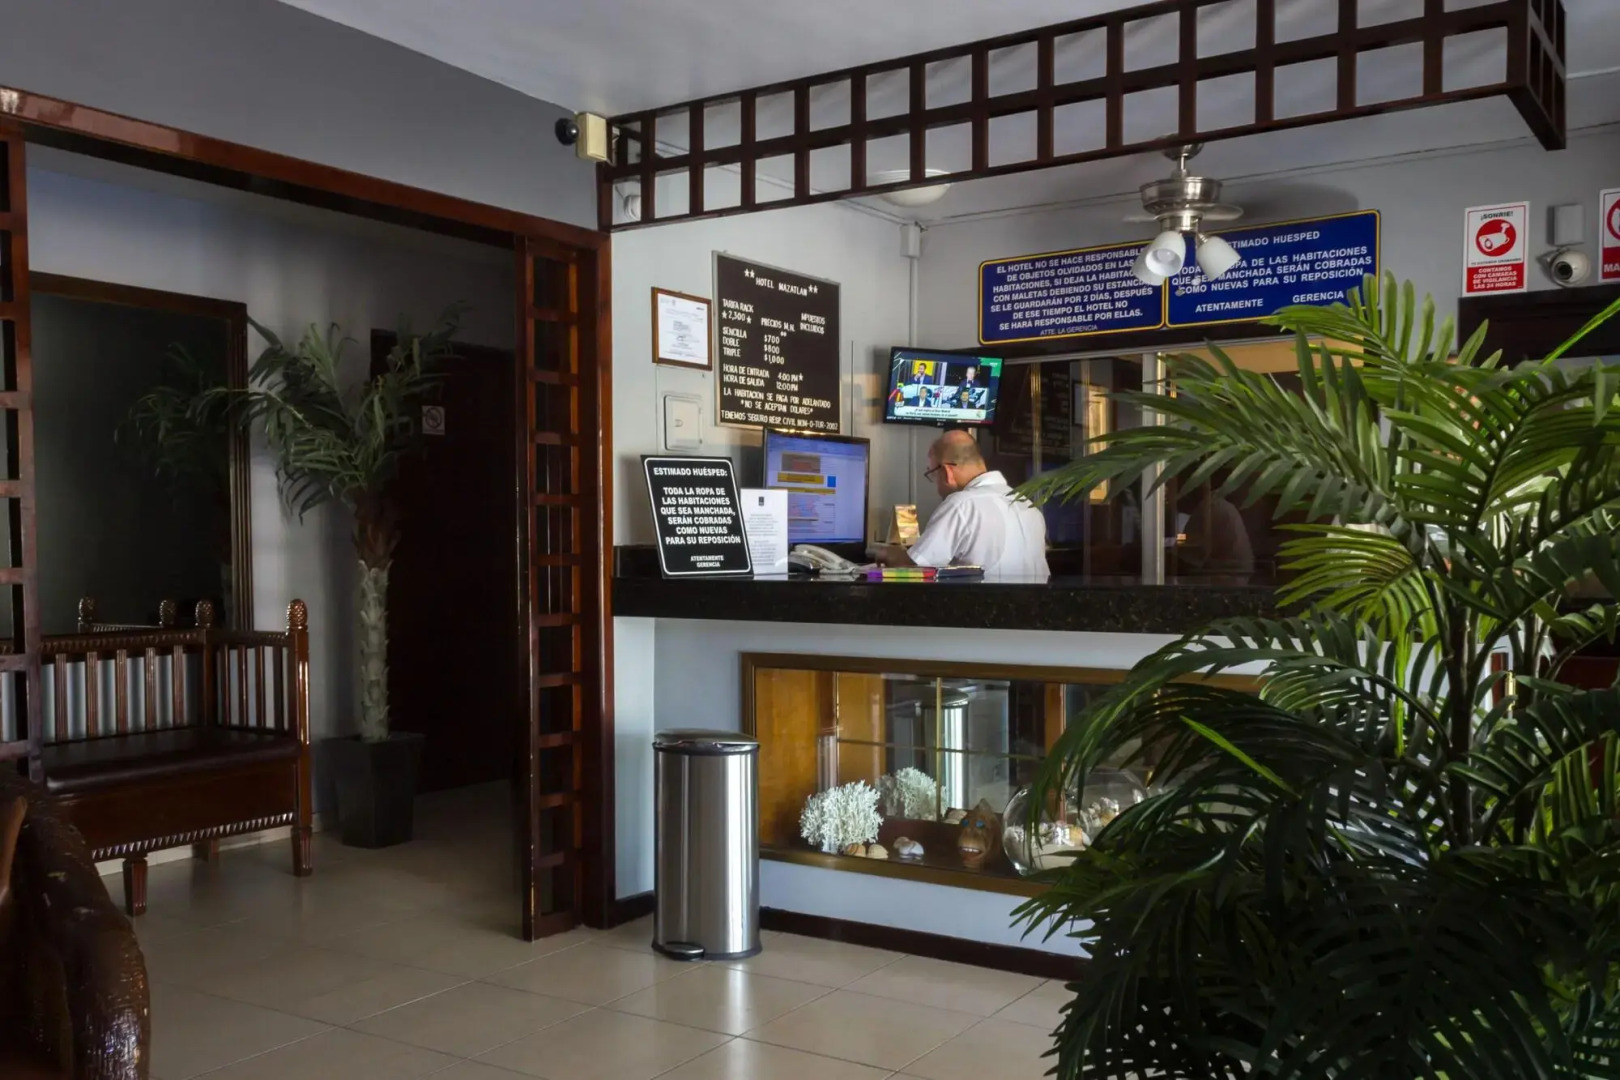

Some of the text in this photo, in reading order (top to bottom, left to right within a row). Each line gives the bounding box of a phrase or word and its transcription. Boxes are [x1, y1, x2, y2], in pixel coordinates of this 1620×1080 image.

[1228, 231, 1320, 248] TIMADO HUESPED
[1008, 263, 1033, 272] HOTEL
[1061, 256, 1083, 265] HACE
[1179, 266, 1201, 274] ODA
[1252, 258, 1264, 266] DE
[1269, 255, 1288, 265] LAS
[1292, 246, 1367, 262] HABITACIONES
[1019, 270, 1055, 280] OBJETOS
[1057, 264, 1103, 276] OLVIDADOS
[1119, 260, 1134, 268] LAS
[1172, 277, 1191, 286] QUE
[1276, 262, 1310, 274] SERÁN
[1314, 256, 1372, 270] COBRADAS
[993, 280, 1052, 293] HABITACIONES,
[1064, 276, 1084, 285] DEJA
[1211, 280, 1248, 291] NUEVAS
[1253, 277, 1279, 287] PARA
[1283, 275, 1296, 284] SU
[1301, 266, 1363, 282] REPOSICIÓN
[756, 277, 807, 296] HOTEL MAZATLAN
[993, 294, 1010, 302] CON
[1012, 290, 1047, 300] MALETAS
[1050, 284, 1091, 296] DEBIENDO
[1014, 296, 1062, 310] GUARDARÁN
[1064, 296, 1081, 304] POR
[1114, 286, 1153, 298] DESPUÉS
[1195, 290, 1344, 313] ATENTAMENTE GERENCIA
[740, 302, 754, 313] RACK
[1042, 306, 1072, 316] TIEMPO
[1086, 302, 1113, 312] HOTEL
[761, 317, 782, 328] PRECIOS
[1011, 319, 1032, 329] HARÁ
[1035, 314, 1092, 327] RESPONSABLE
[1114, 309, 1142, 318] ELLAS.
[723, 326, 747, 339] SENCILLA
[1067, 324, 1098, 333] GERENCIA
[723, 337, 740, 347] DOBLE
[764, 335, 780, 344] $700
[723, 347, 740, 357] TRIPLE
[764, 345, 780, 354] $800
[723, 364, 737, 374] HORA
[739, 366, 746, 375] DE
[747, 367, 769, 378] ENTRADA
[723, 375, 738, 384] HORA
[747, 378, 765, 387] SALIDA
[724, 388, 732, 396] LA
[734, 389, 764, 400] HABITACION
[776, 394, 788, 403] PAGA
[790, 396, 799, 404] POR
[802, 398, 831, 408] ADELANTADO
[755, 401, 762, 409] SE
[765, 403, 787, 412] ACEPTAN
[721, 410, 746, 420] TENEMOS
[783, 417, 796, 427] CIVIL
[654, 467, 728, 476] ESTIMADO HUÉSPED:
[663, 487, 683, 495] TODA
[660, 507, 677, 515] QUE
[694, 507, 735, 516] MANCHADA,
[668, 515, 692, 525] SERÁN
[665, 537, 686, 545] PARA
[698, 535, 741, 544] REPOSICIÓN
